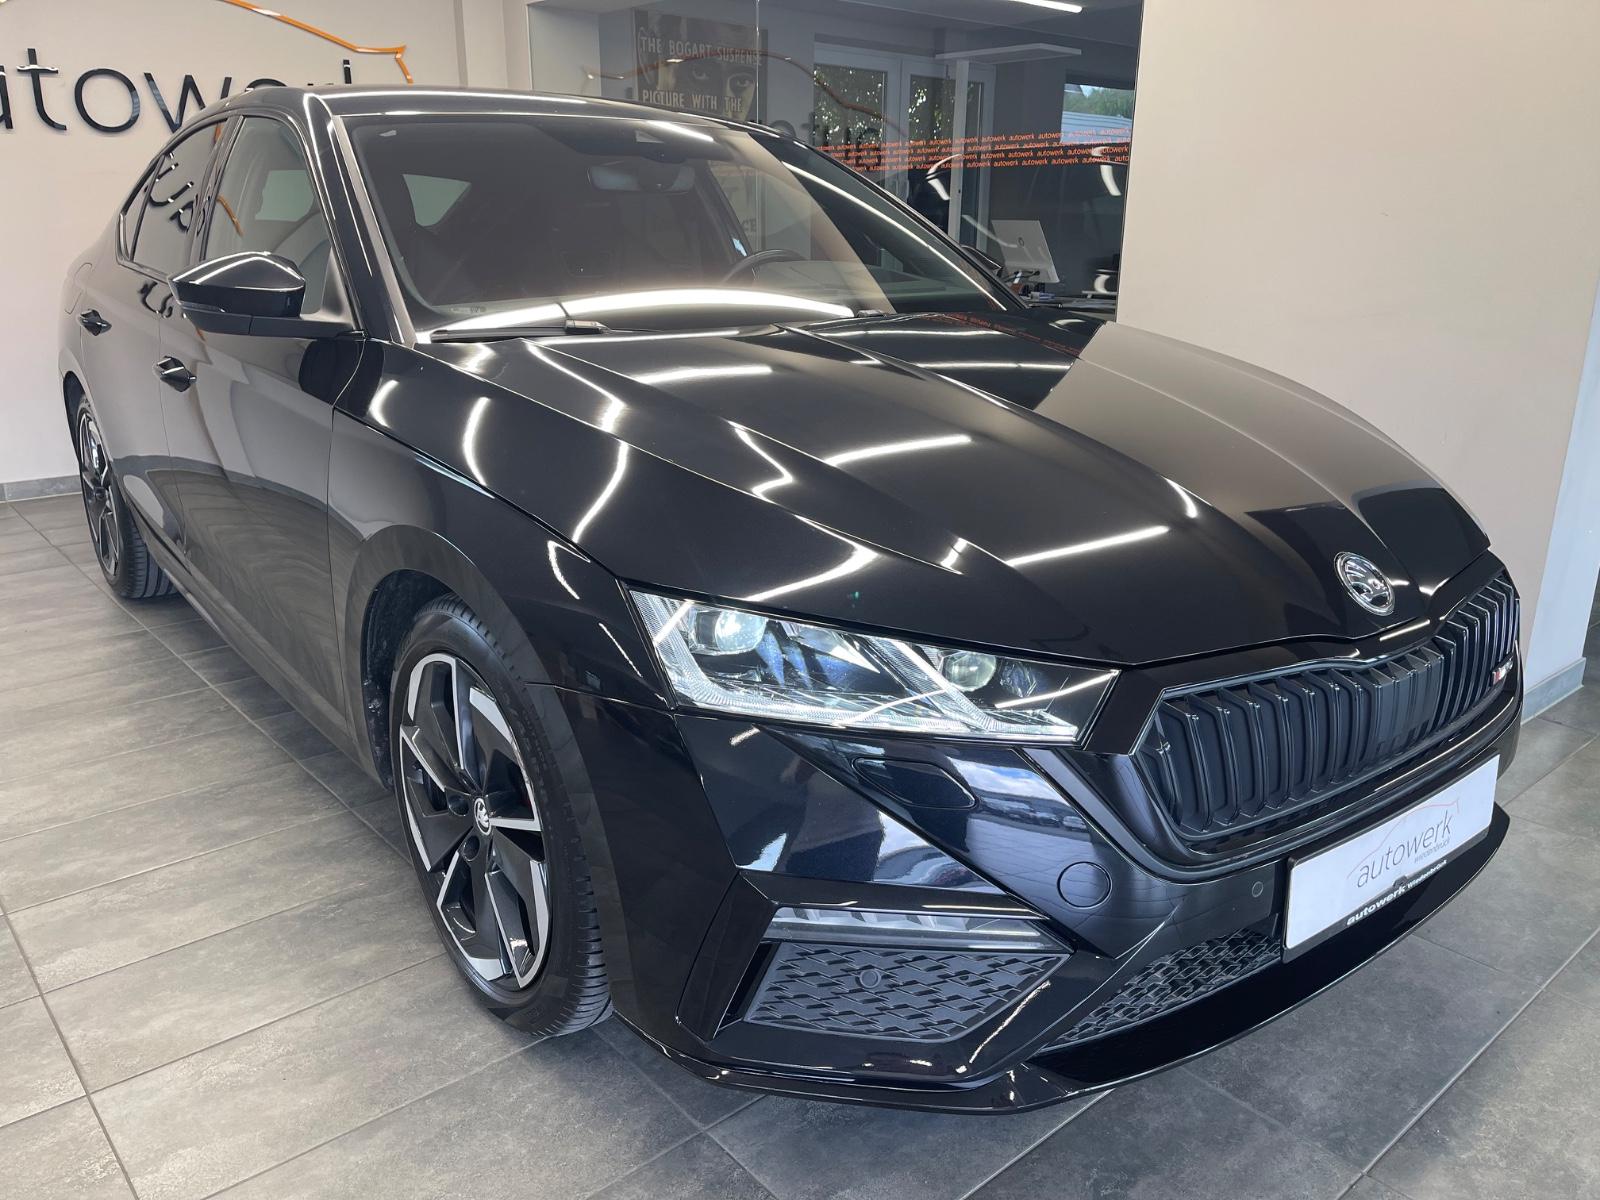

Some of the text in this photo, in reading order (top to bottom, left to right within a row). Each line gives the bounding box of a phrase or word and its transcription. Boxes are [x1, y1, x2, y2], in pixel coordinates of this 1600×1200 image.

[640, 36, 662, 53] THE
[669, 40, 712, 58] BOGART
[642, 90, 743, 113] PICTURE WITH THE
[1357, 810, 1452, 888] autowerk
[1347, 885, 1407, 925] autowerk
